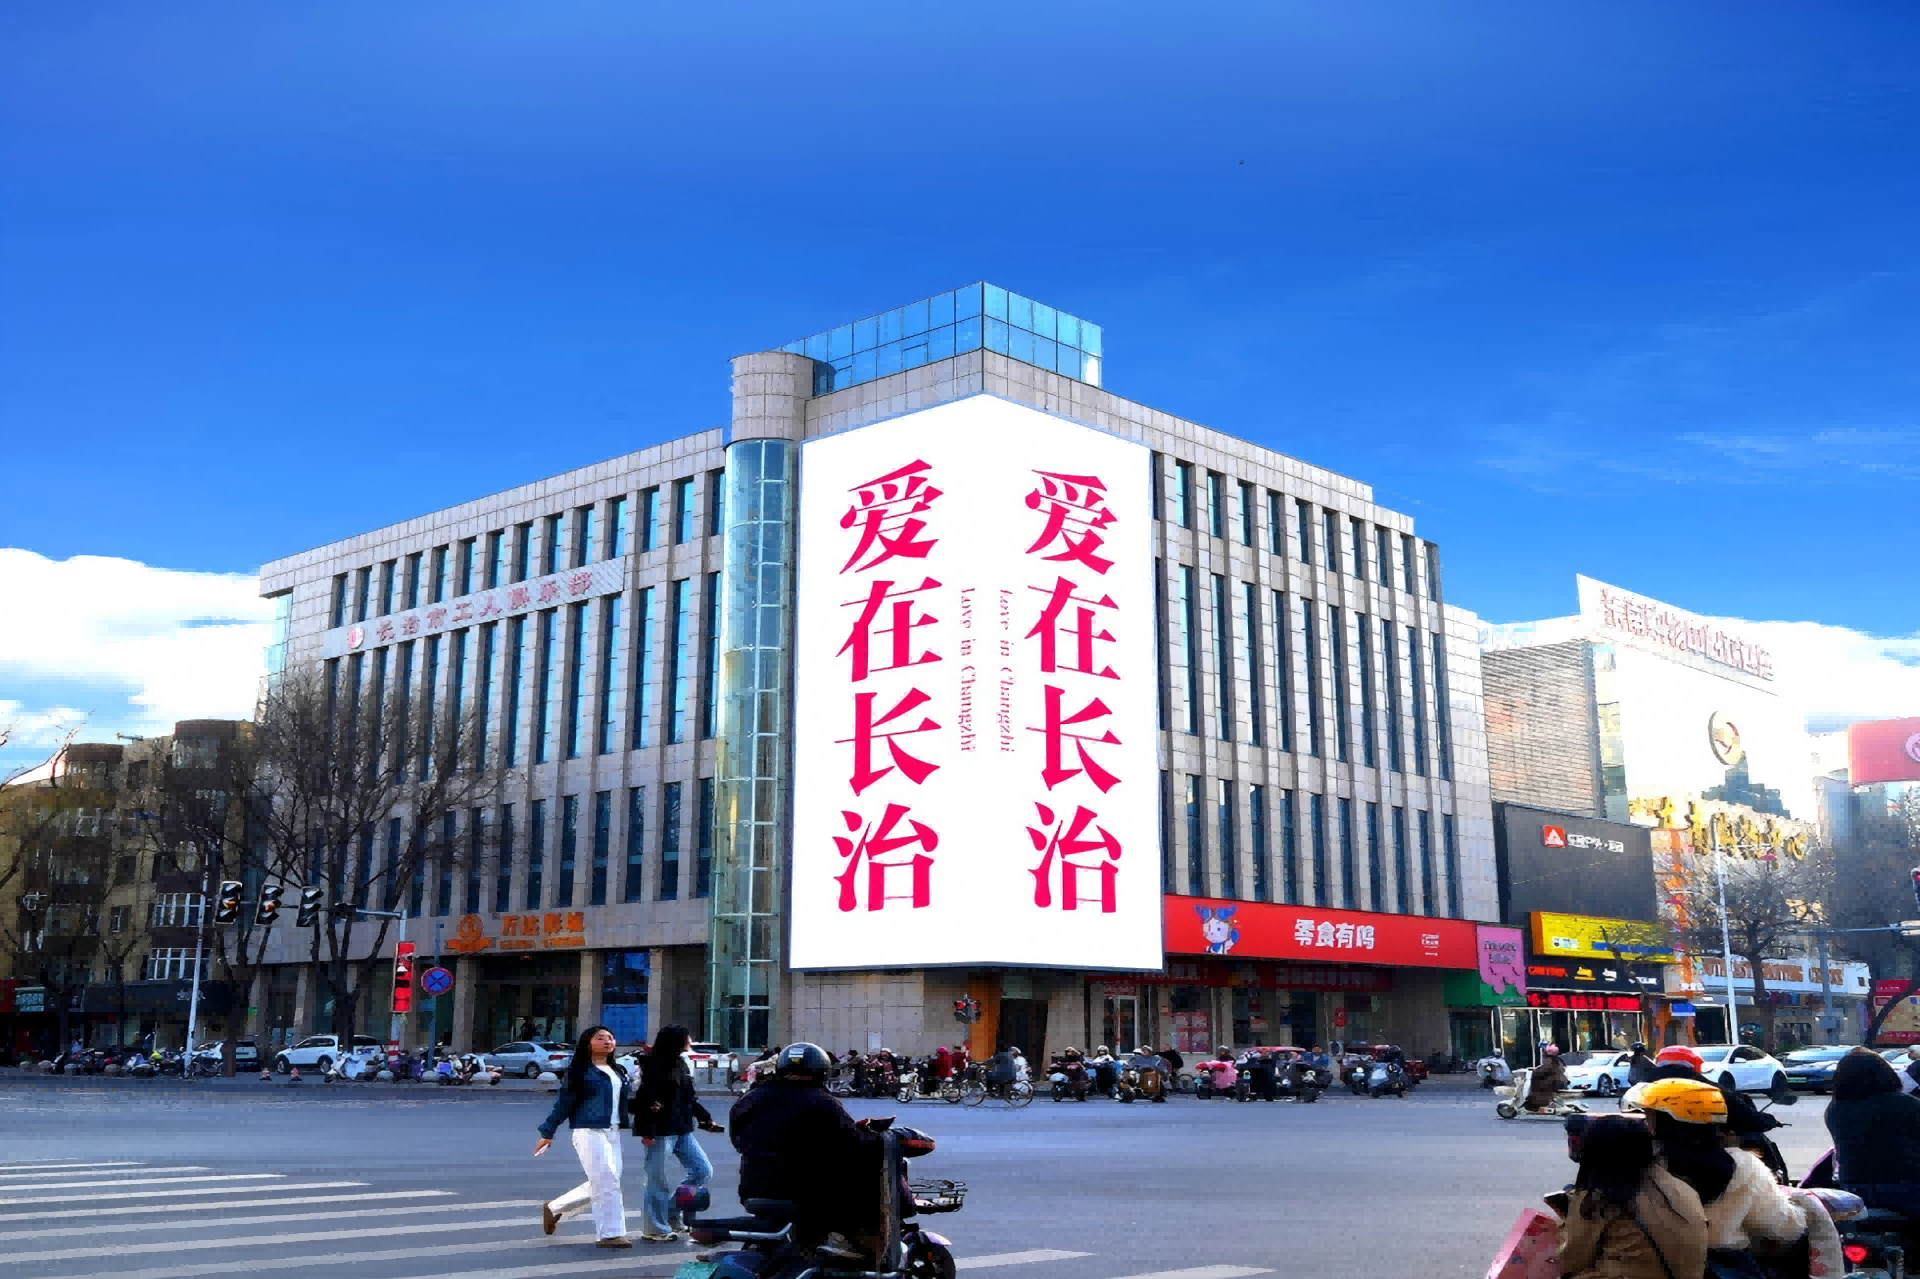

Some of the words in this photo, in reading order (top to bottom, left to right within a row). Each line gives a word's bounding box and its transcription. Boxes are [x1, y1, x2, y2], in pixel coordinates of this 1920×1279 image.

[960, 588, 976, 628] Love
[1000, 589, 1013, 630] Love
[960, 639, 976, 657] in
[1000, 640, 1014, 657] in
[832, 459, 943, 912] 爱在长治
[1025, 470, 1122, 913] 爱在长治
[958, 665, 976, 752] Changzhi
[998, 667, 1014, 752] Changzhi
[1294, 918, 1375, 950] 零食有鸣
